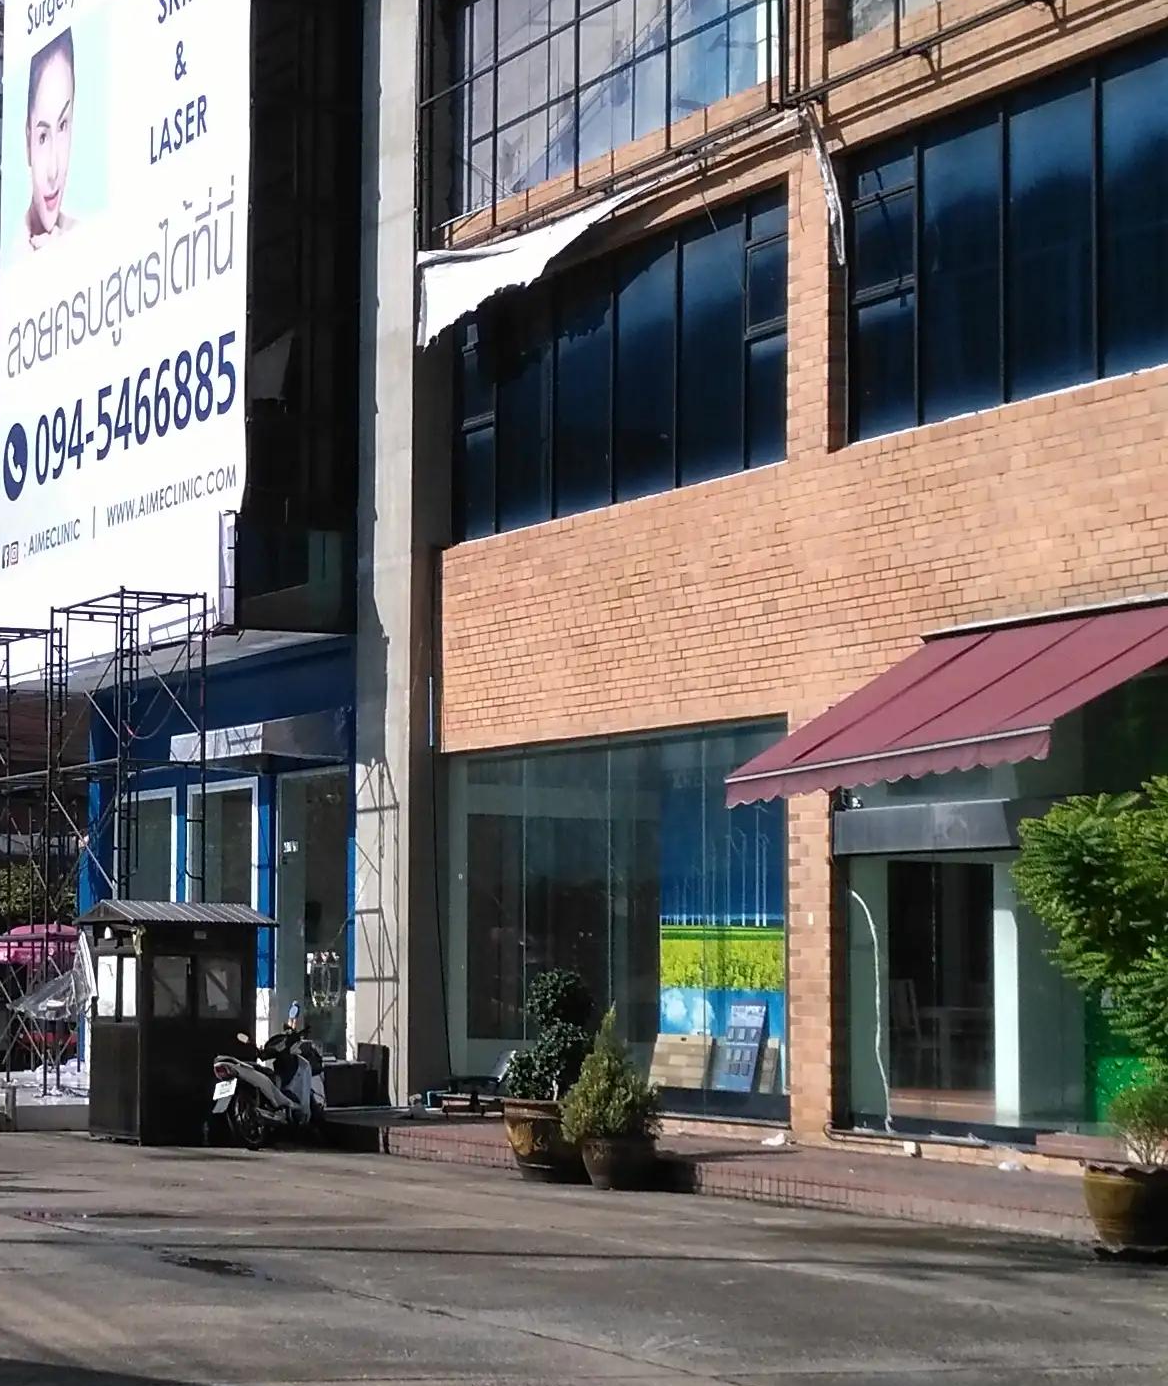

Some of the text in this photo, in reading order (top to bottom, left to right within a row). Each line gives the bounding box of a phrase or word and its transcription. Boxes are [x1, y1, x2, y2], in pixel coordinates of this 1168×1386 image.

[174, 40, 187, 81] &
[149, 94, 208, 165] LASER
[34, 330, 237, 486] 094-5466885
[28, 464, 237, 557] AIMECLINIC WWW.AIMECLINIC.COM
